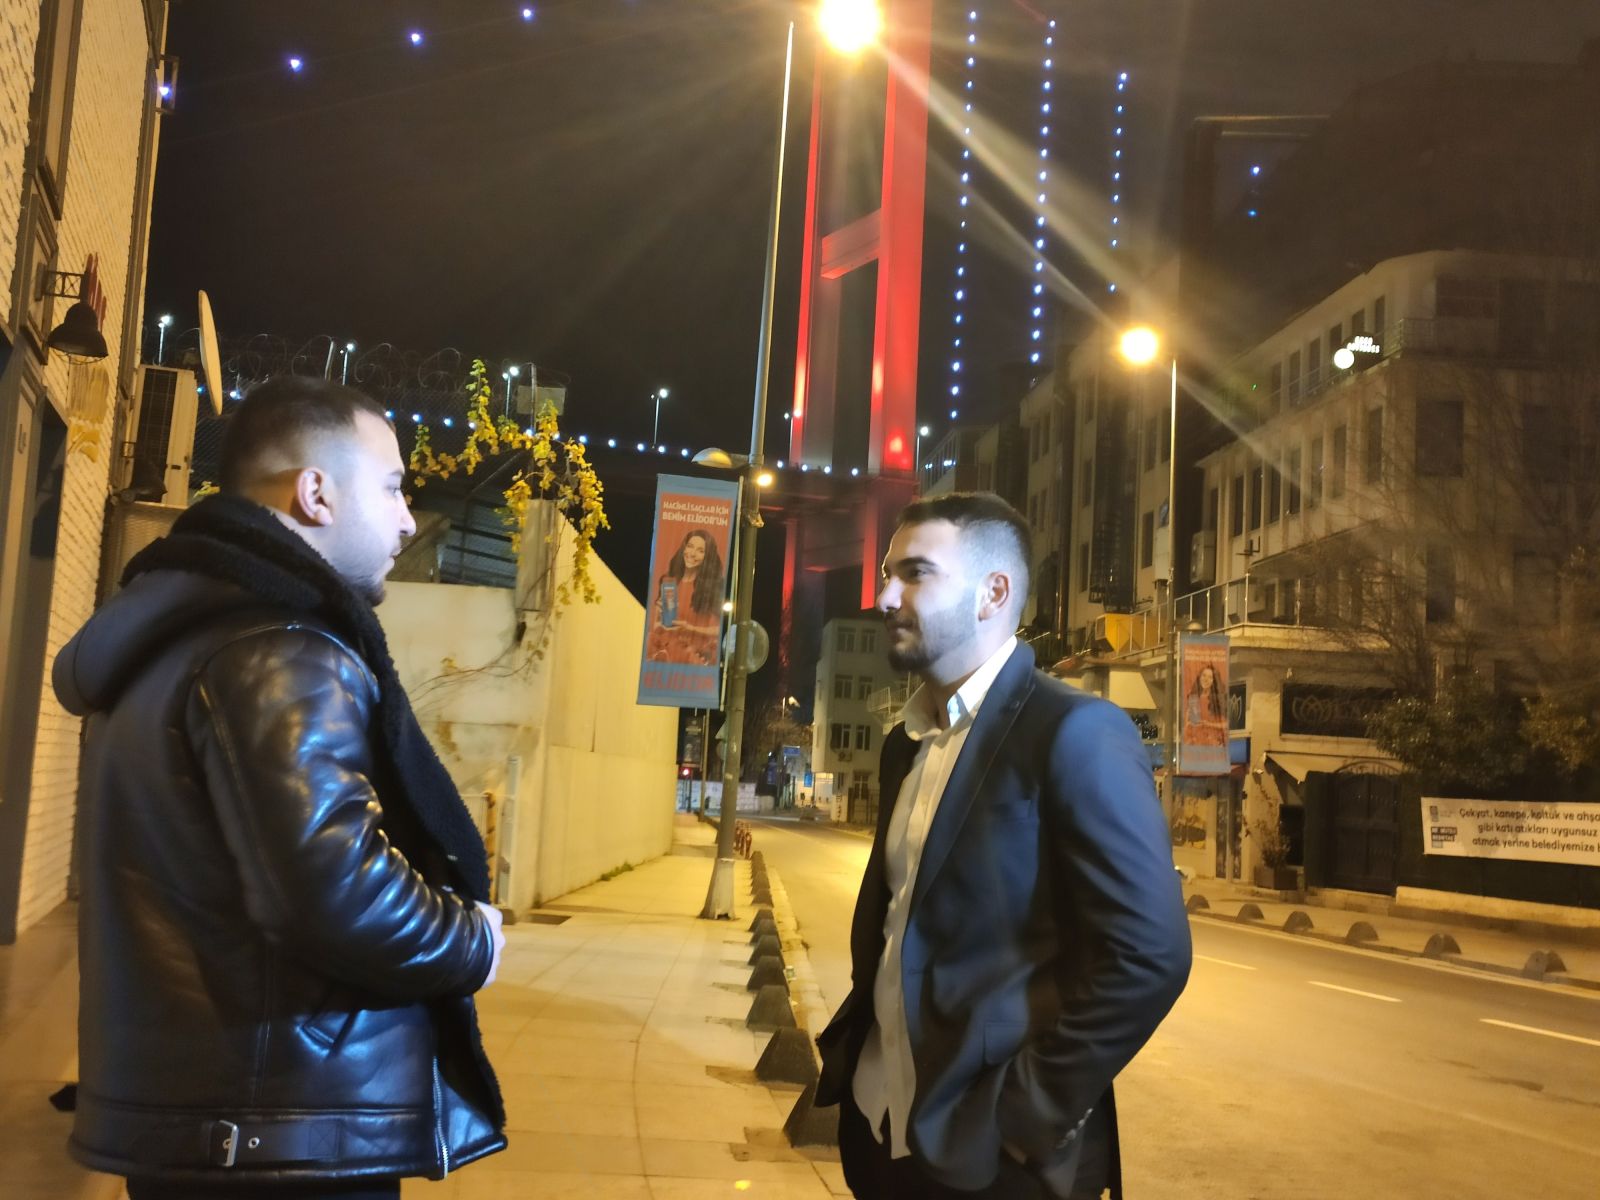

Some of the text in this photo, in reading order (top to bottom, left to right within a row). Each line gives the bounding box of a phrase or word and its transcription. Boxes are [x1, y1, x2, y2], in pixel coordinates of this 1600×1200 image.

[1494, 809, 1530, 820] kanepe,
[1530, 809, 1560, 820] koltuk
[1563, 812, 1574, 821] ve
[1478, 822, 1494, 834] gibi
[1551, 827, 1598, 838] uygunsuz
[1472, 837, 1500, 847] atmak
[1502, 837, 1530, 849] yerine
[1531, 838, 1595, 853] belediyemize
